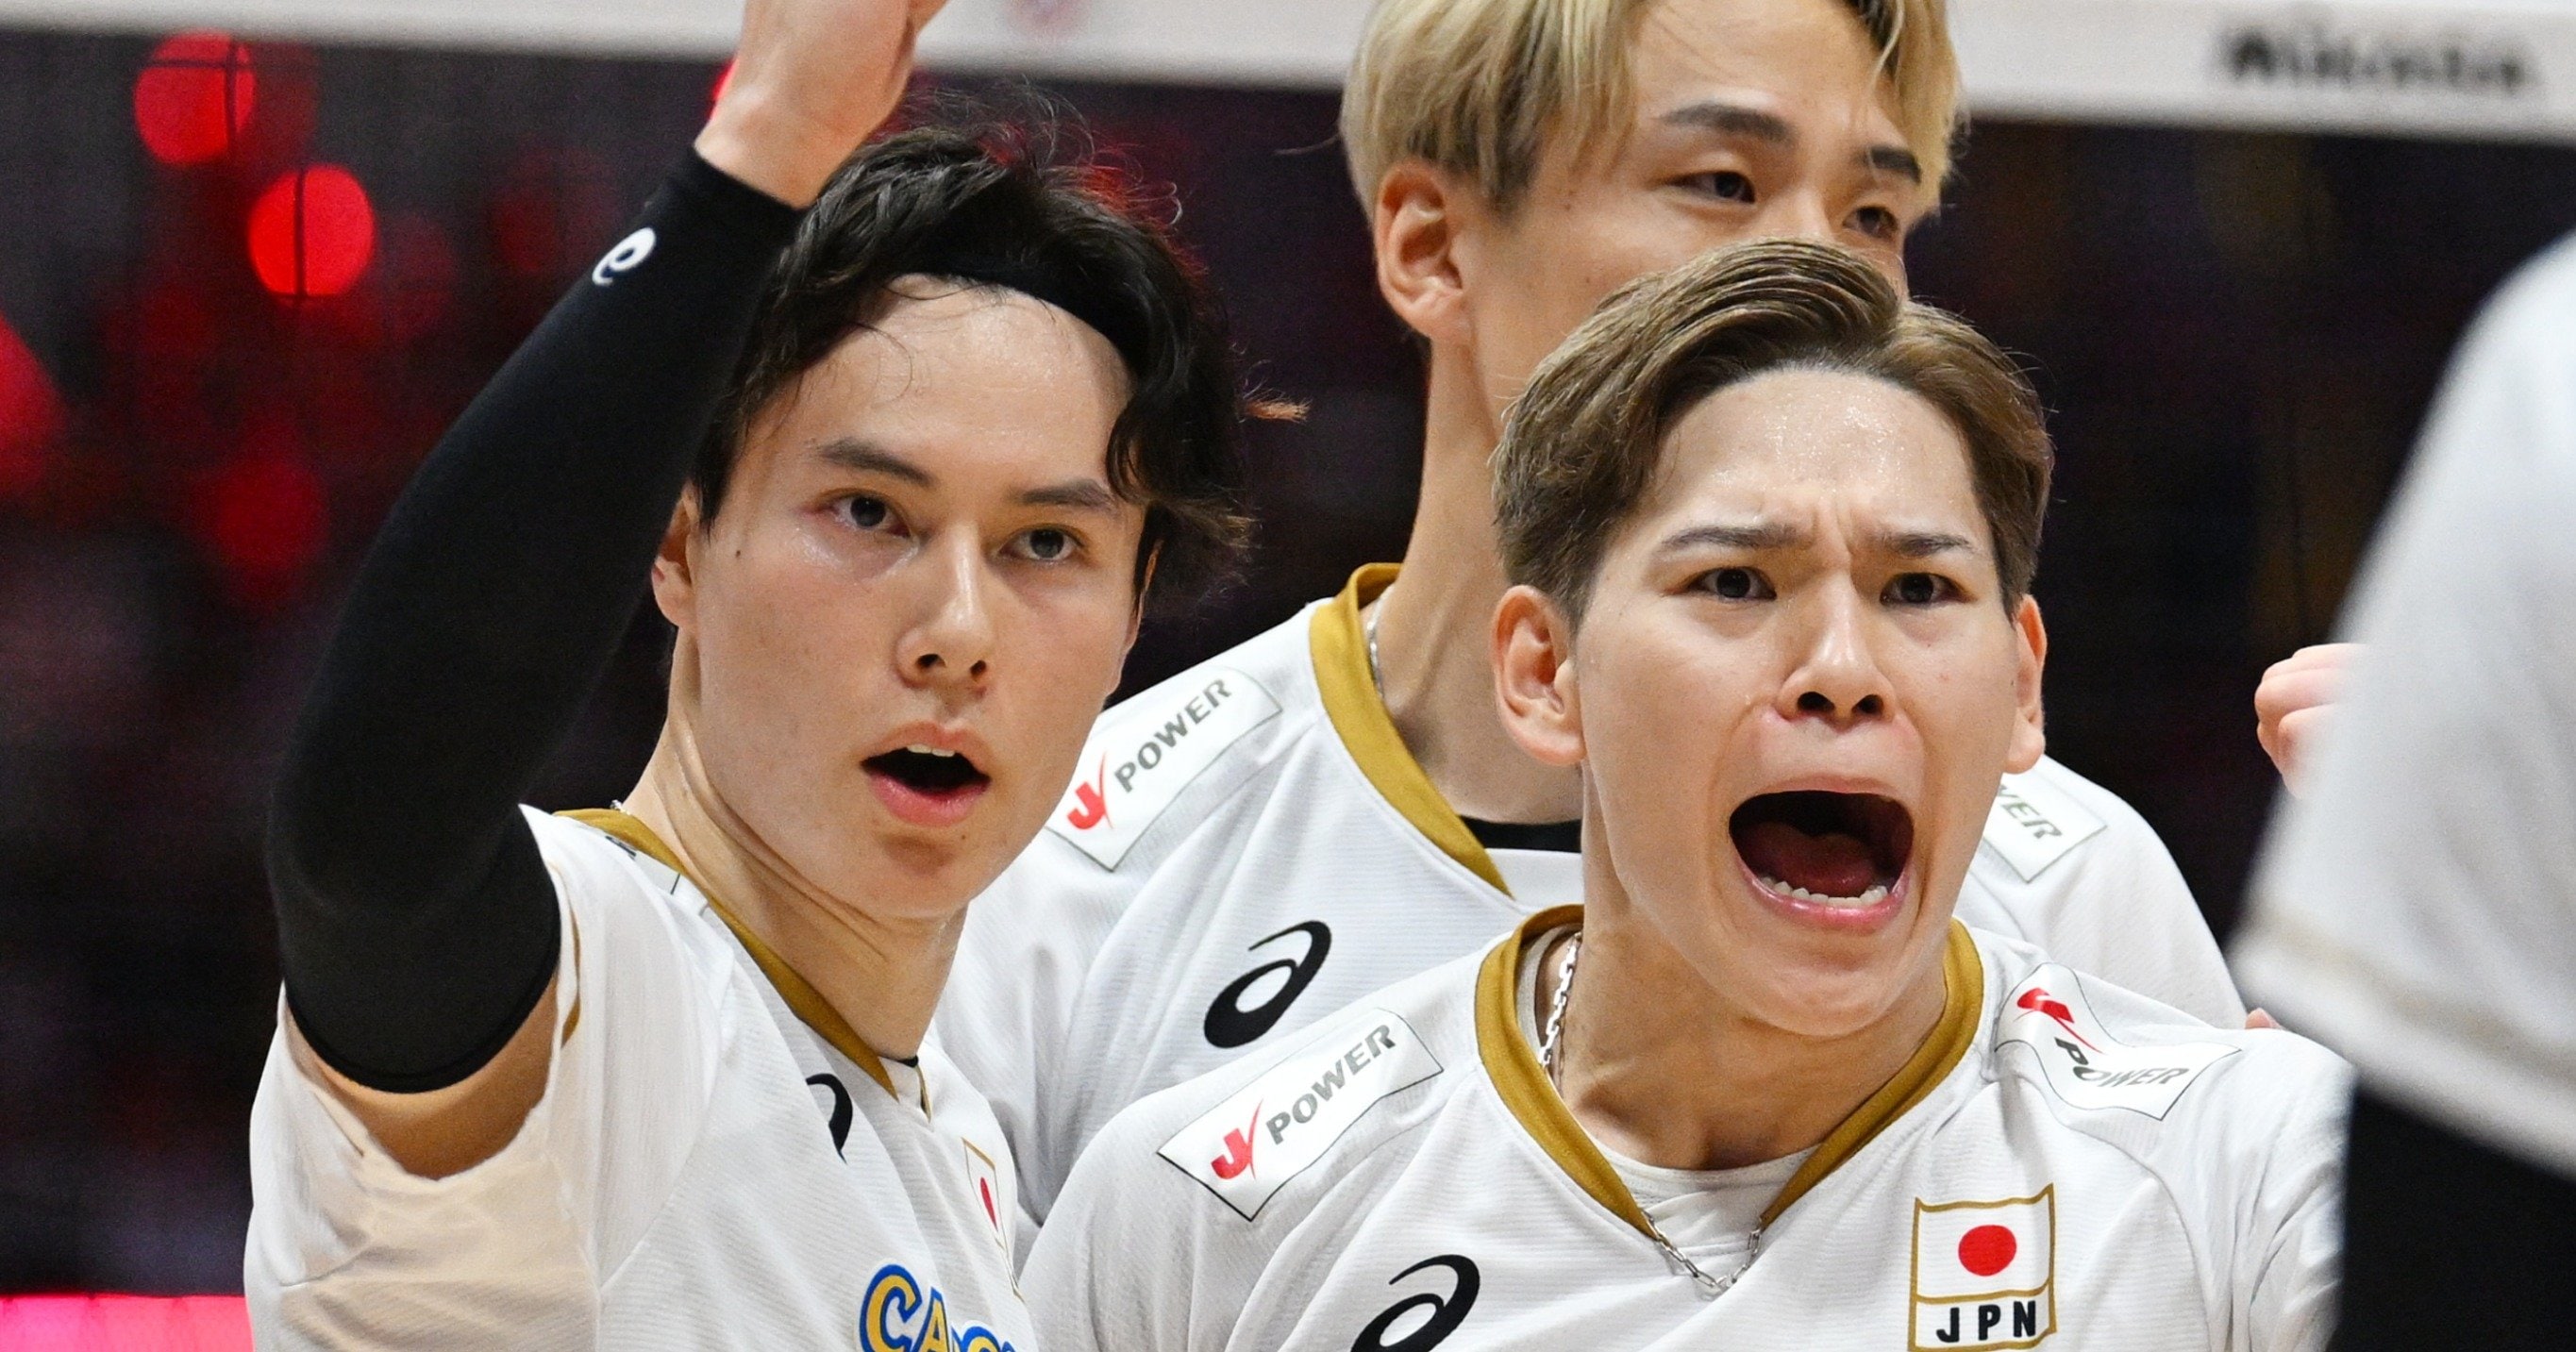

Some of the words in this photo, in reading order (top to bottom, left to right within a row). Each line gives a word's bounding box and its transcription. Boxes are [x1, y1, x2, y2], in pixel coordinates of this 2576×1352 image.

[1113, 678, 1232, 793] POWER
[1264, 1024, 1397, 1145] POWER
[2053, 1036, 2190, 1088] POWER
[1935, 1299, 2037, 1344] JPN
